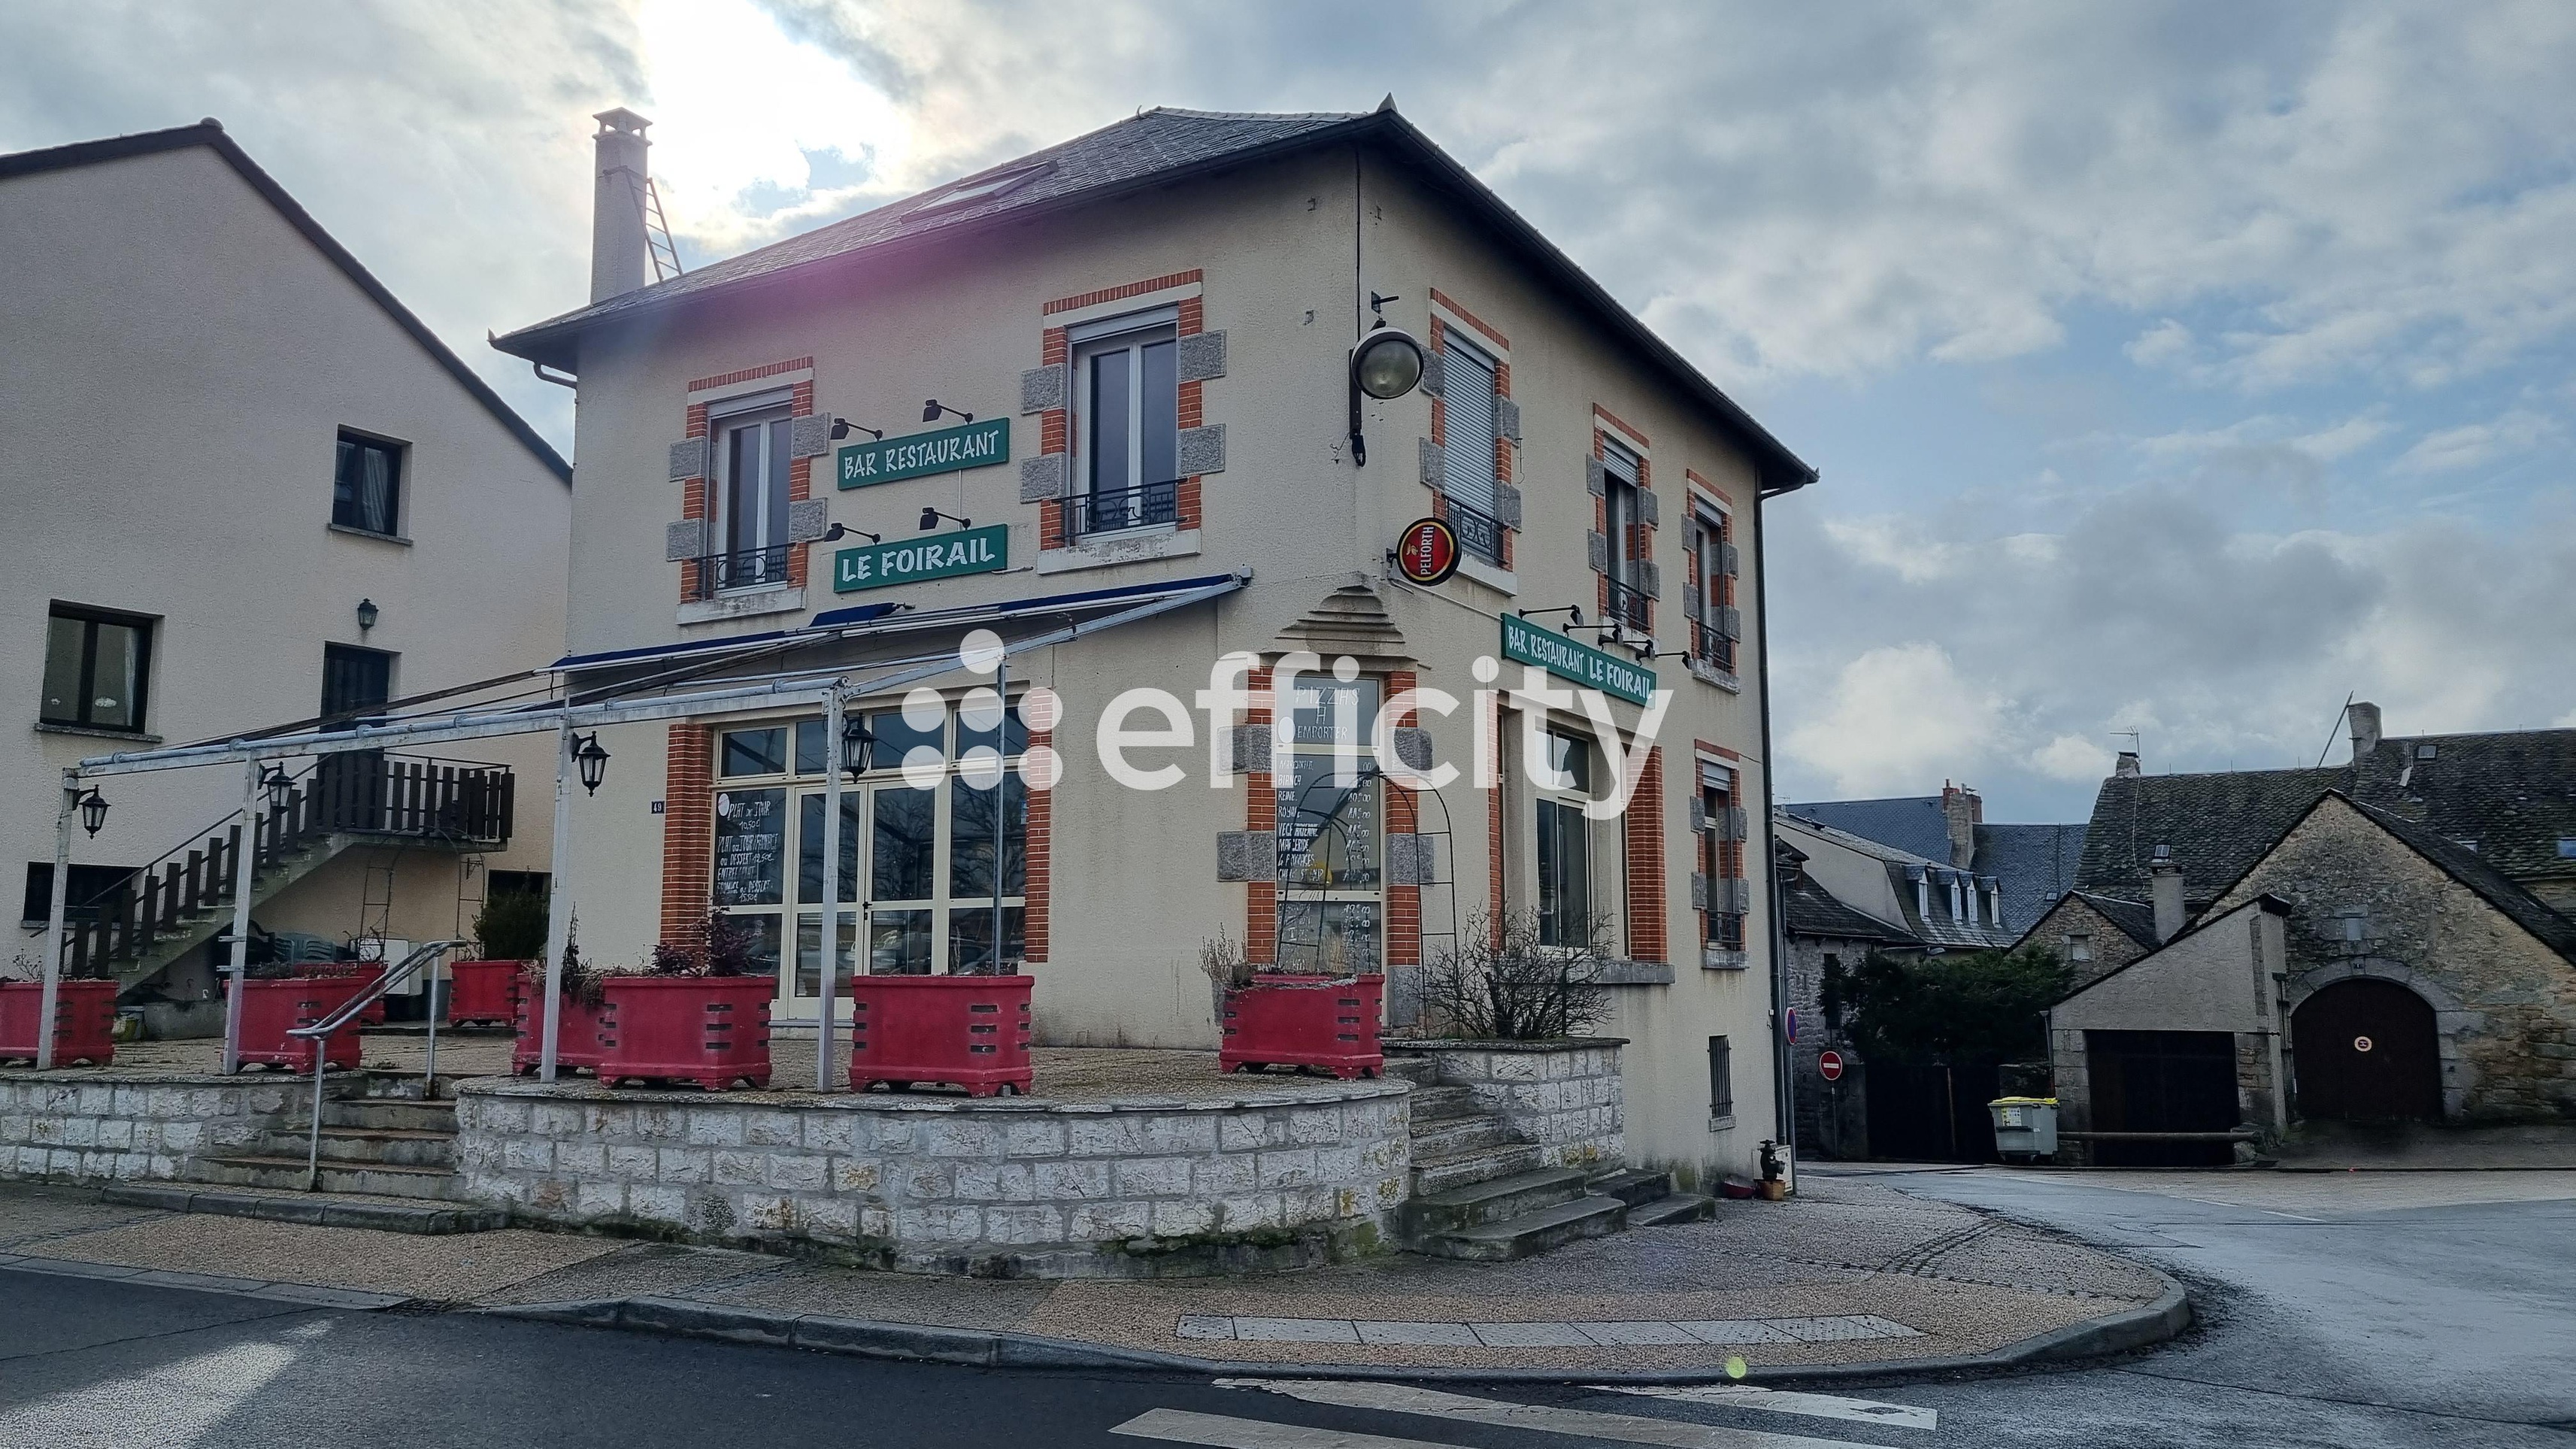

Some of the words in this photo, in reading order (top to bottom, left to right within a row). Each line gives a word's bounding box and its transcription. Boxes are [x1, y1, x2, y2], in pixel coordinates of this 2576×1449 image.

[844, 452, 878, 480] BAR
[885, 429, 999, 472] RESTAURANT
[841, 554, 872, 582] LE
[880, 537, 996, 577] FOIRAIL
[1420, 526, 1435, 575] PELFORTH
[1508, 625, 1528, 654] BAR
[1530, 634, 1584, 675] RESTAURANT
[1590, 656, 1604, 682] LE
[1607, 662, 1653, 700] FOIRAIL
[1295, 686, 1360, 705] PIZZAS
[1297, 725, 1348, 739] EMPORTER
[653, 802, 662, 812] 49
[727, 802, 746, 819] PLAT
[717, 835, 734, 853] PLAT
[730, 852, 753, 865] DESSERT
